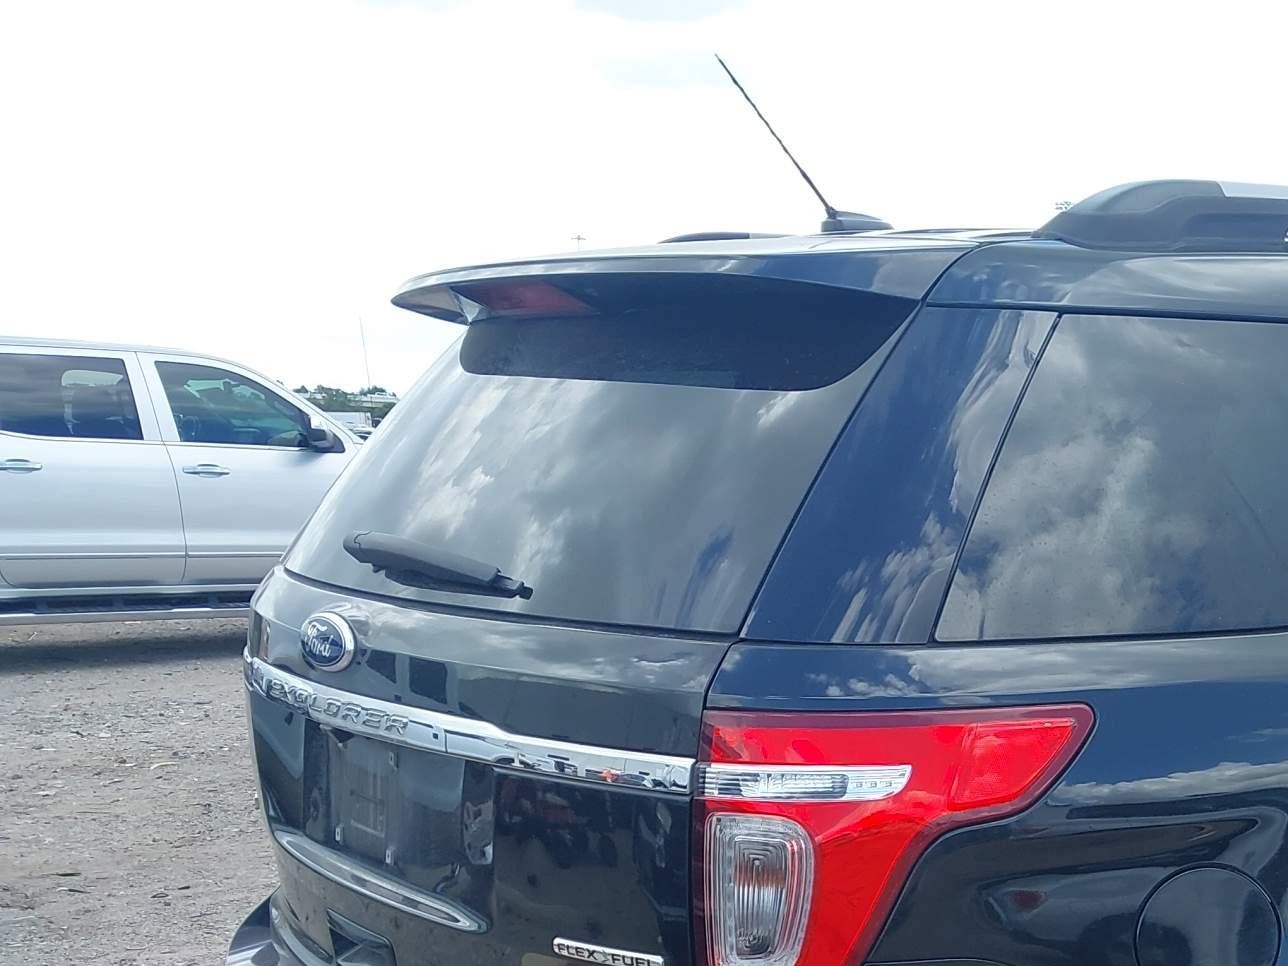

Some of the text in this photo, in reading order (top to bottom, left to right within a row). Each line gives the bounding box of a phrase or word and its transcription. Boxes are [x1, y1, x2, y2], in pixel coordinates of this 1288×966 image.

[304, 621, 334, 658] Ford
[269, 678, 409, 735] EXPLORER
[557, 943, 599, 961] FLEX
